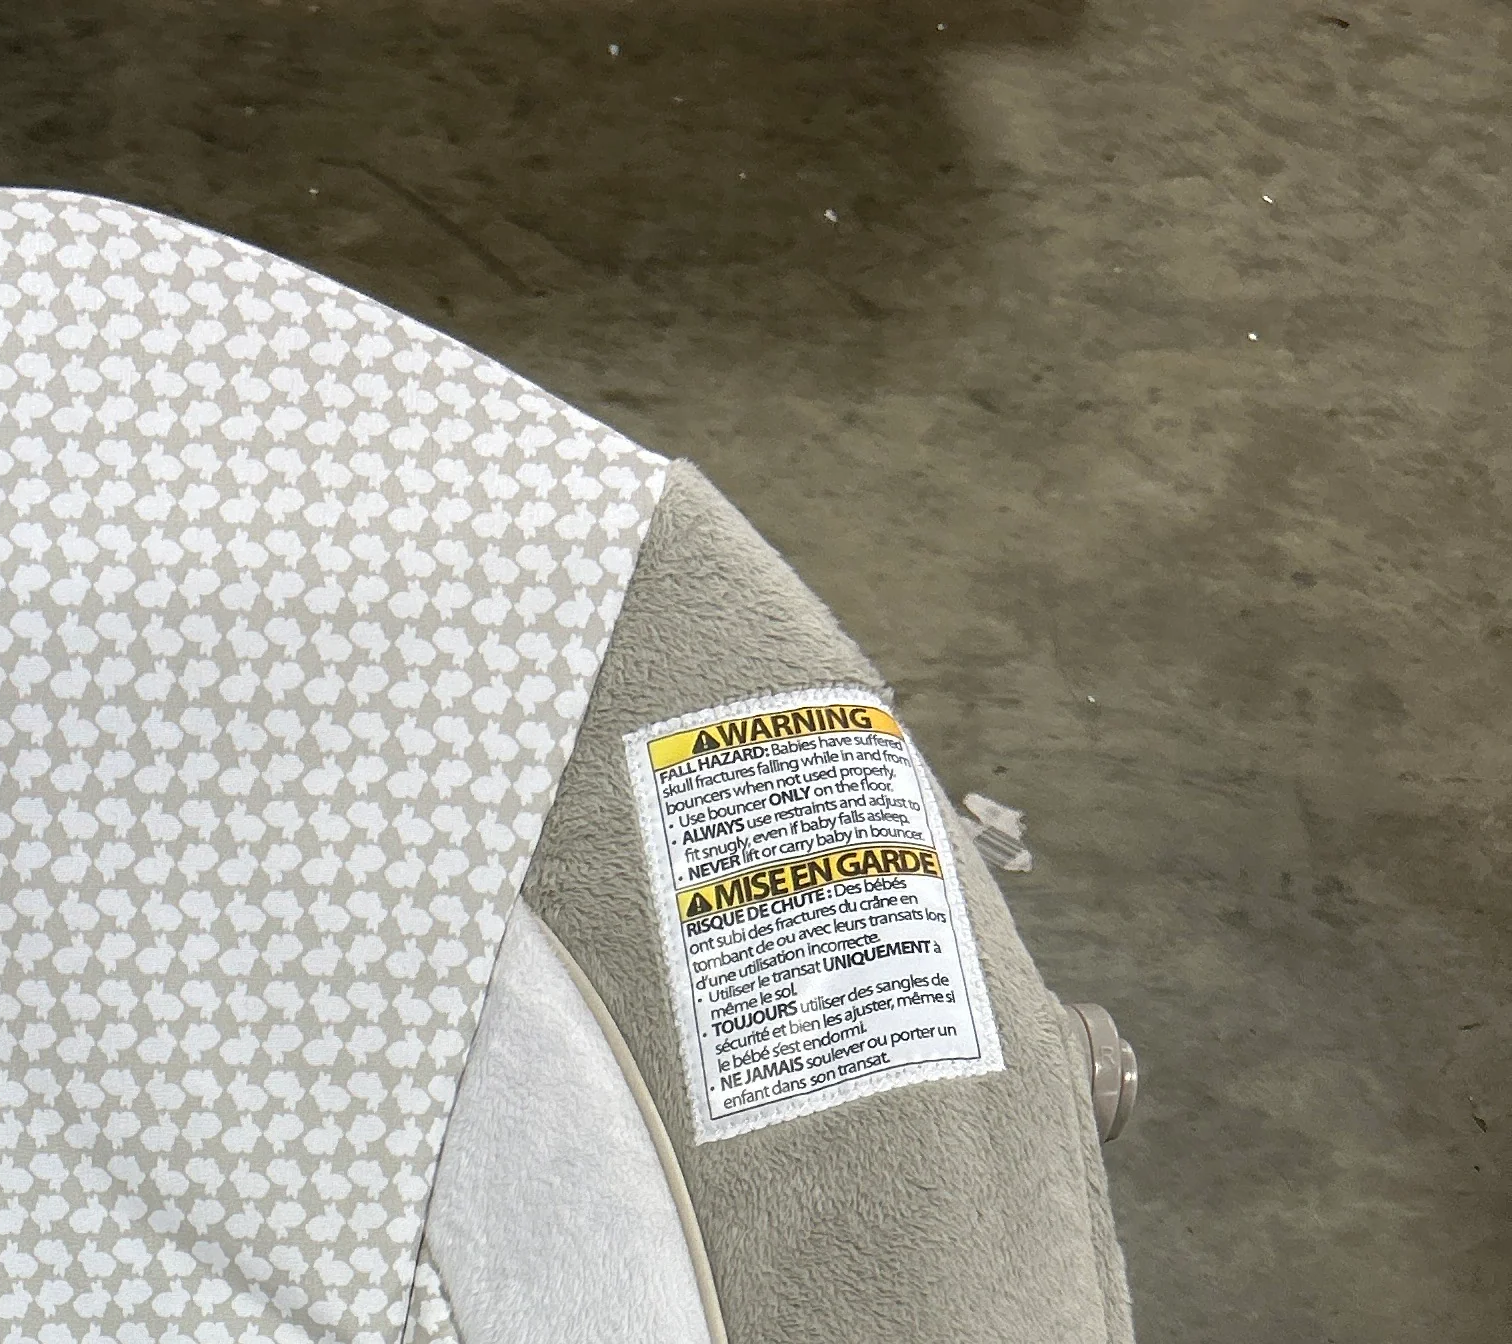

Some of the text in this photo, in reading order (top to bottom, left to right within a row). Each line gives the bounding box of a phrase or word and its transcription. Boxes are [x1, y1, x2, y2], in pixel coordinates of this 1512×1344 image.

[717, 708, 872, 747] WARNING
[660, 734, 903, 784] FALL HAZARD: Babies have suffered
[663, 750, 911, 798] skull fractures falling while in and from
[666, 766, 897, 814] bouncers when not used properly.
[679, 779, 893, 827] Use bouncer ONLY on the floor.
[682, 796, 920, 844] ALWAYS use restraints and adjust to
[685, 846, 702, 863] fit
[703, 838, 750, 858] snugly,
[752, 829, 788, 844] even
[789, 822, 800, 835] if
[801, 815, 835, 833] baby
[837, 812, 865, 827] falls
[688, 855, 739, 880] NEVER
[742, 851, 759, 865] lift
[762, 848, 777, 858] or
[779, 838, 814, 856] carry
[816, 829, 852, 847] baby
[855, 826, 868, 838] in
[687, 911, 744, 937] RISQUE
[747, 904, 769, 921] DE
[835, 883, 862, 897] Des
[864, 878, 907, 894] bébés
[714, 852, 938, 911] MISE EN GARDE
[689, 894, 918, 955] ont subi des fractures du crâne en
[693, 909, 946, 973] tombant de ou avec leurs transats lors
[708, 941, 942, 1003] Utiliser le transat UNIQUEMENT à
[738, 948, 804, 977] utilisation
[711, 997, 754, 1020] même
[756, 992, 772, 1006] le
[712, 973, 949, 1037] TOUJOURS utiliser des sangles de
[715, 990, 955, 1055] sécurité et bien les ajuster, même si
[718, 1059, 731, 1073] le
[733, 1048, 770, 1068] bébé
[721, 1024, 957, 1092] NE JAMAIS soulever ou porter un
[724, 1053, 890, 1110] enfant dans son transat.
